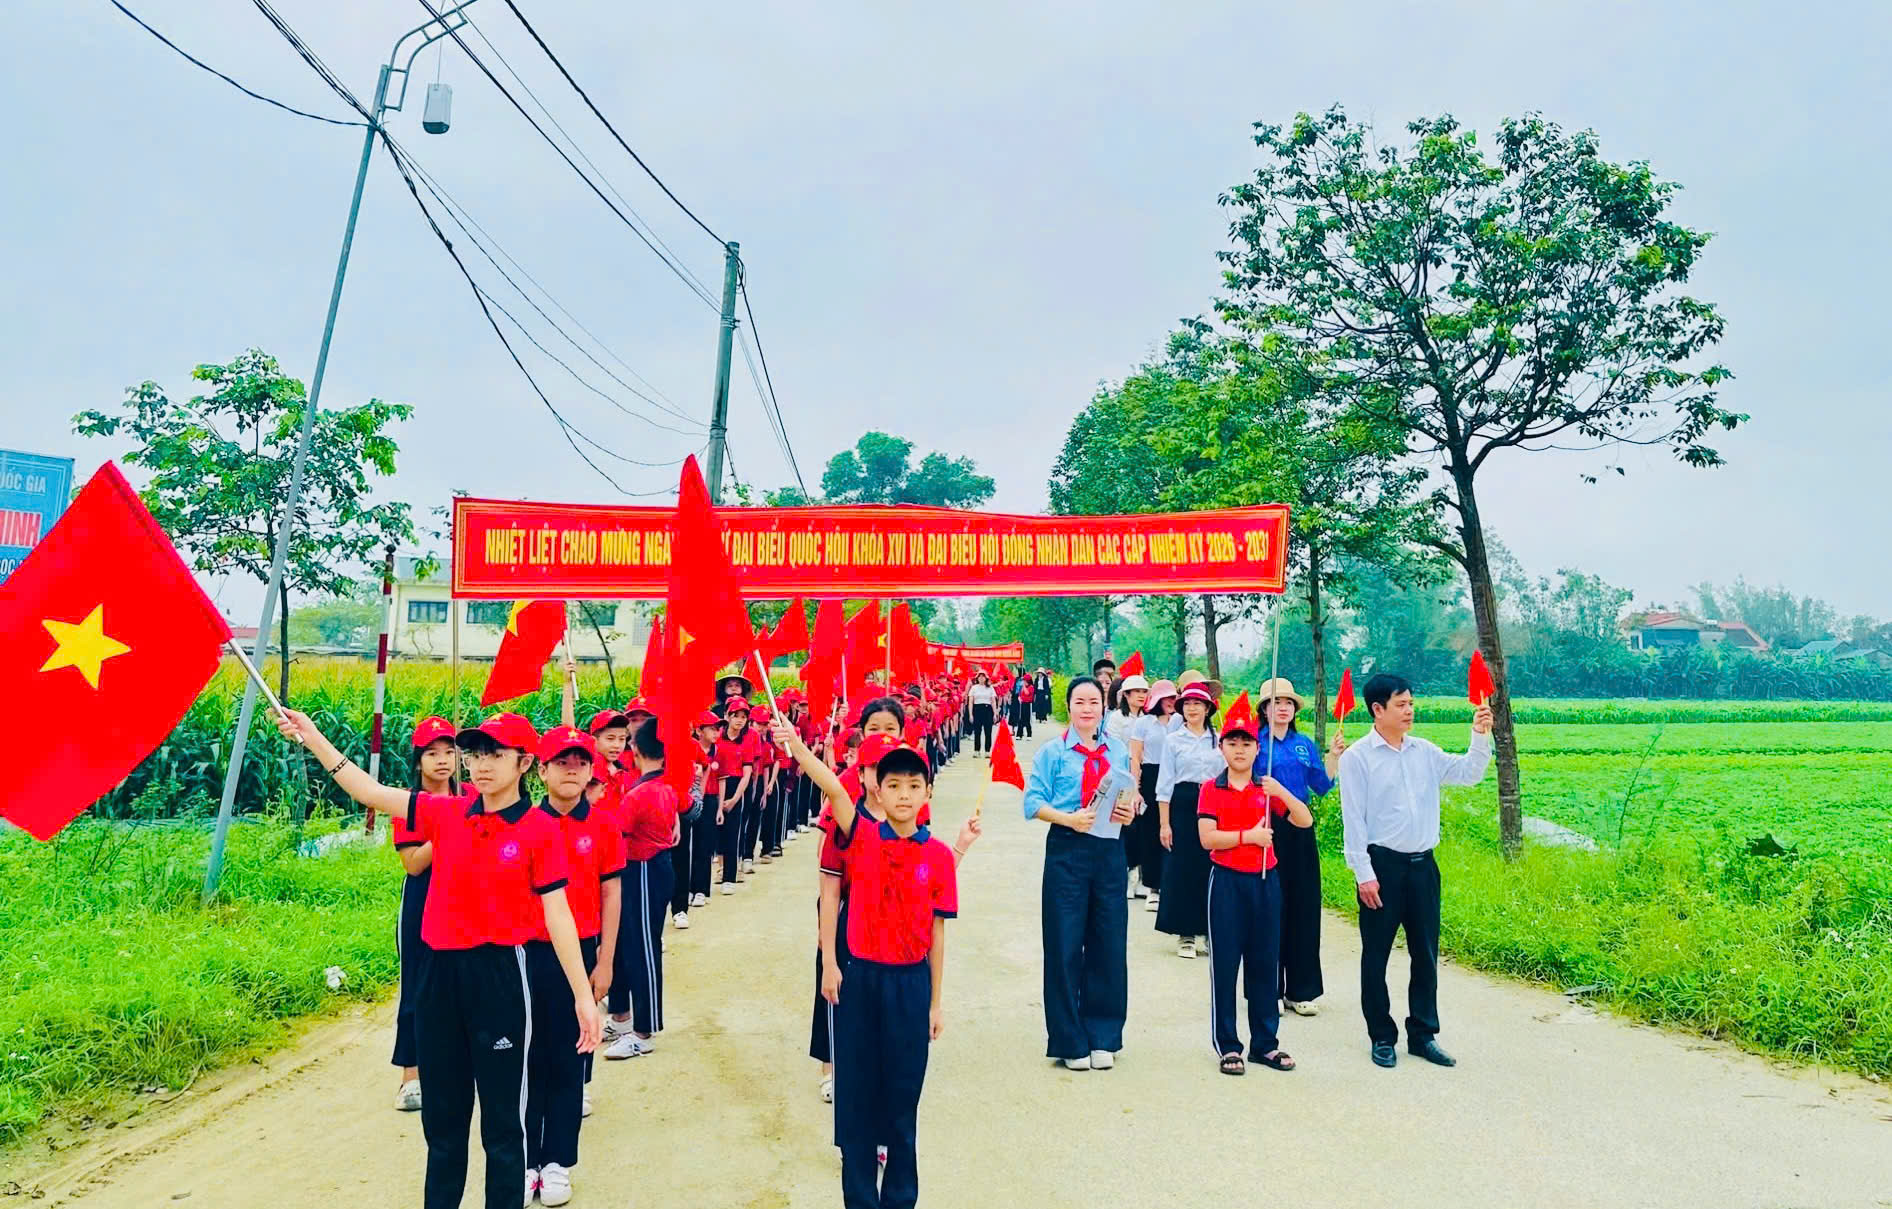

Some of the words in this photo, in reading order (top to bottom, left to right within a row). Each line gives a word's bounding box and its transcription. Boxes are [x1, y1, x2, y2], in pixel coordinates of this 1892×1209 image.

[25, 474, 46, 494] GIA
[485, 521, 526, 573] NHIỆT
[529, 521, 557, 573] LIỆT
[561, 522, 597, 565] CHÀO
[601, 523, 641, 566] MỪNG
[644, 524, 674, 566] NGÀ
[732, 531, 754, 573] ĐẠI
[757, 518, 786, 566] BIỂU
[789, 520, 822, 569] QUỐC
[852, 524, 884, 566] KHÓA
[887, 533, 906, 565] XVI
[910, 527, 924, 565] VÀ
[927, 533, 947, 573] ĐẠI
[951, 520, 976, 565] BIỂU
[980, 527, 999, 573] HỘI
[1002, 524, 1033, 565] ĐỒNG
[1036, 527, 1068, 565] NHÂN
[1071, 527, 1096, 565] DÂN
[1097, 528, 1120, 565] CÁC
[1123, 524, 1147, 564] CẤP
[1149, 527, 1188, 572] NHIỆM
[1206, 531, 1235, 562] 2026
[1245, 529, 1269, 561] 2031
